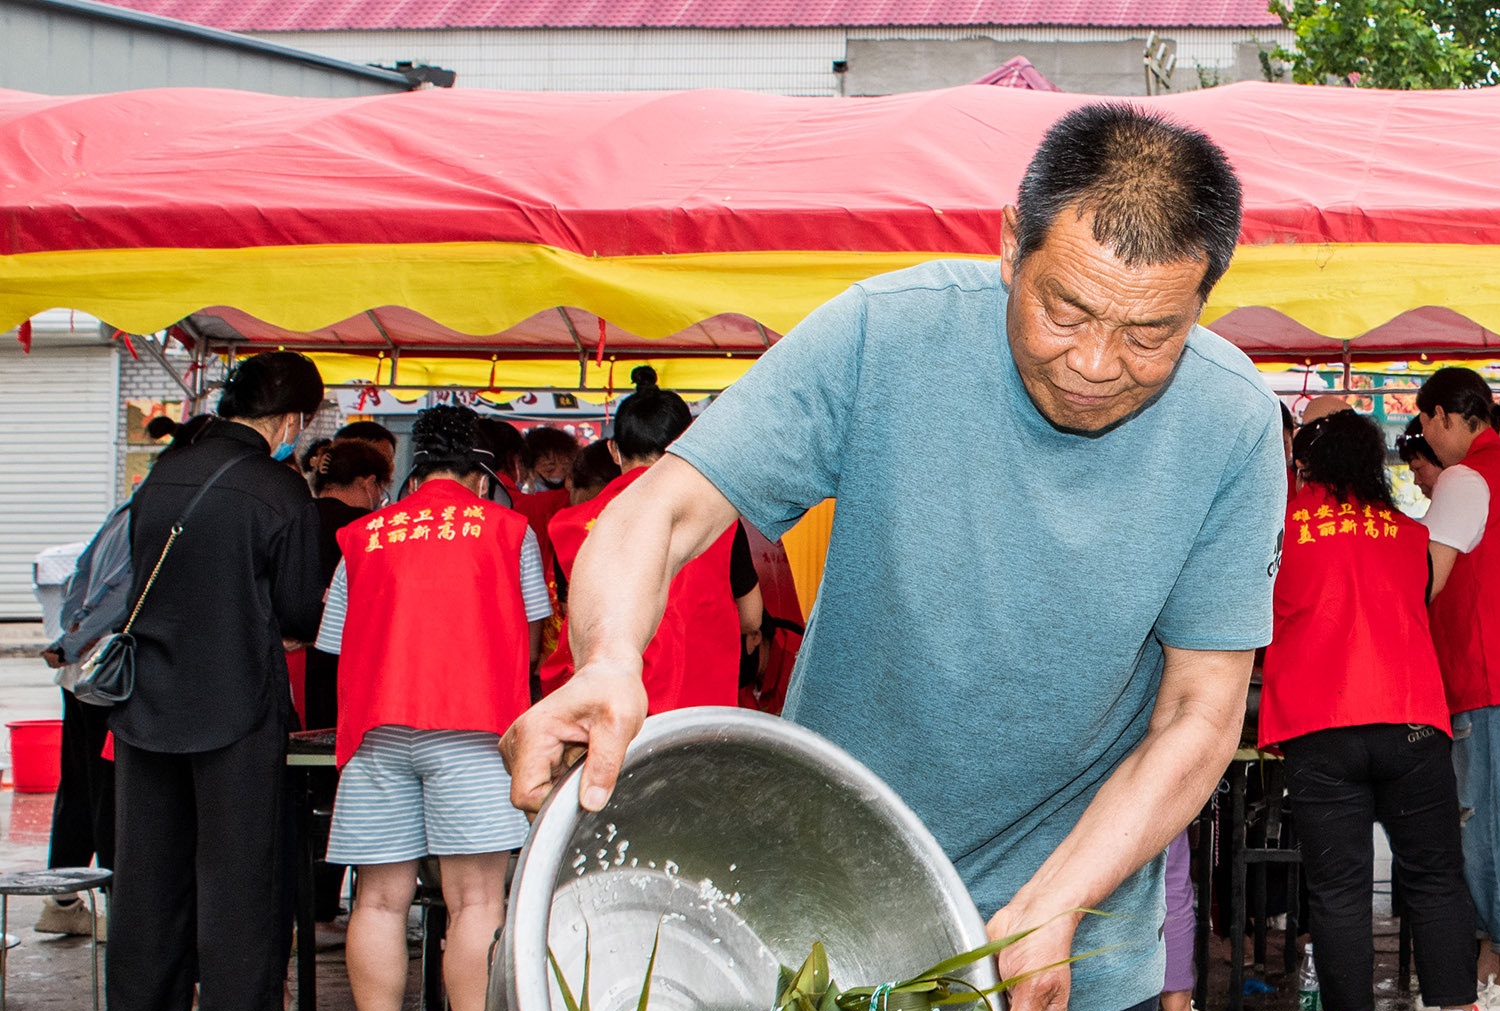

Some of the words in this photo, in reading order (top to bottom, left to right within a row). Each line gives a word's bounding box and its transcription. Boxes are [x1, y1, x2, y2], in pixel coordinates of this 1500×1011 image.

[365, 504, 486, 533] 雄安卫星城
[1297, 518, 1399, 544] 美丽新高阳
[365, 521, 483, 552] 美丽新高阳
